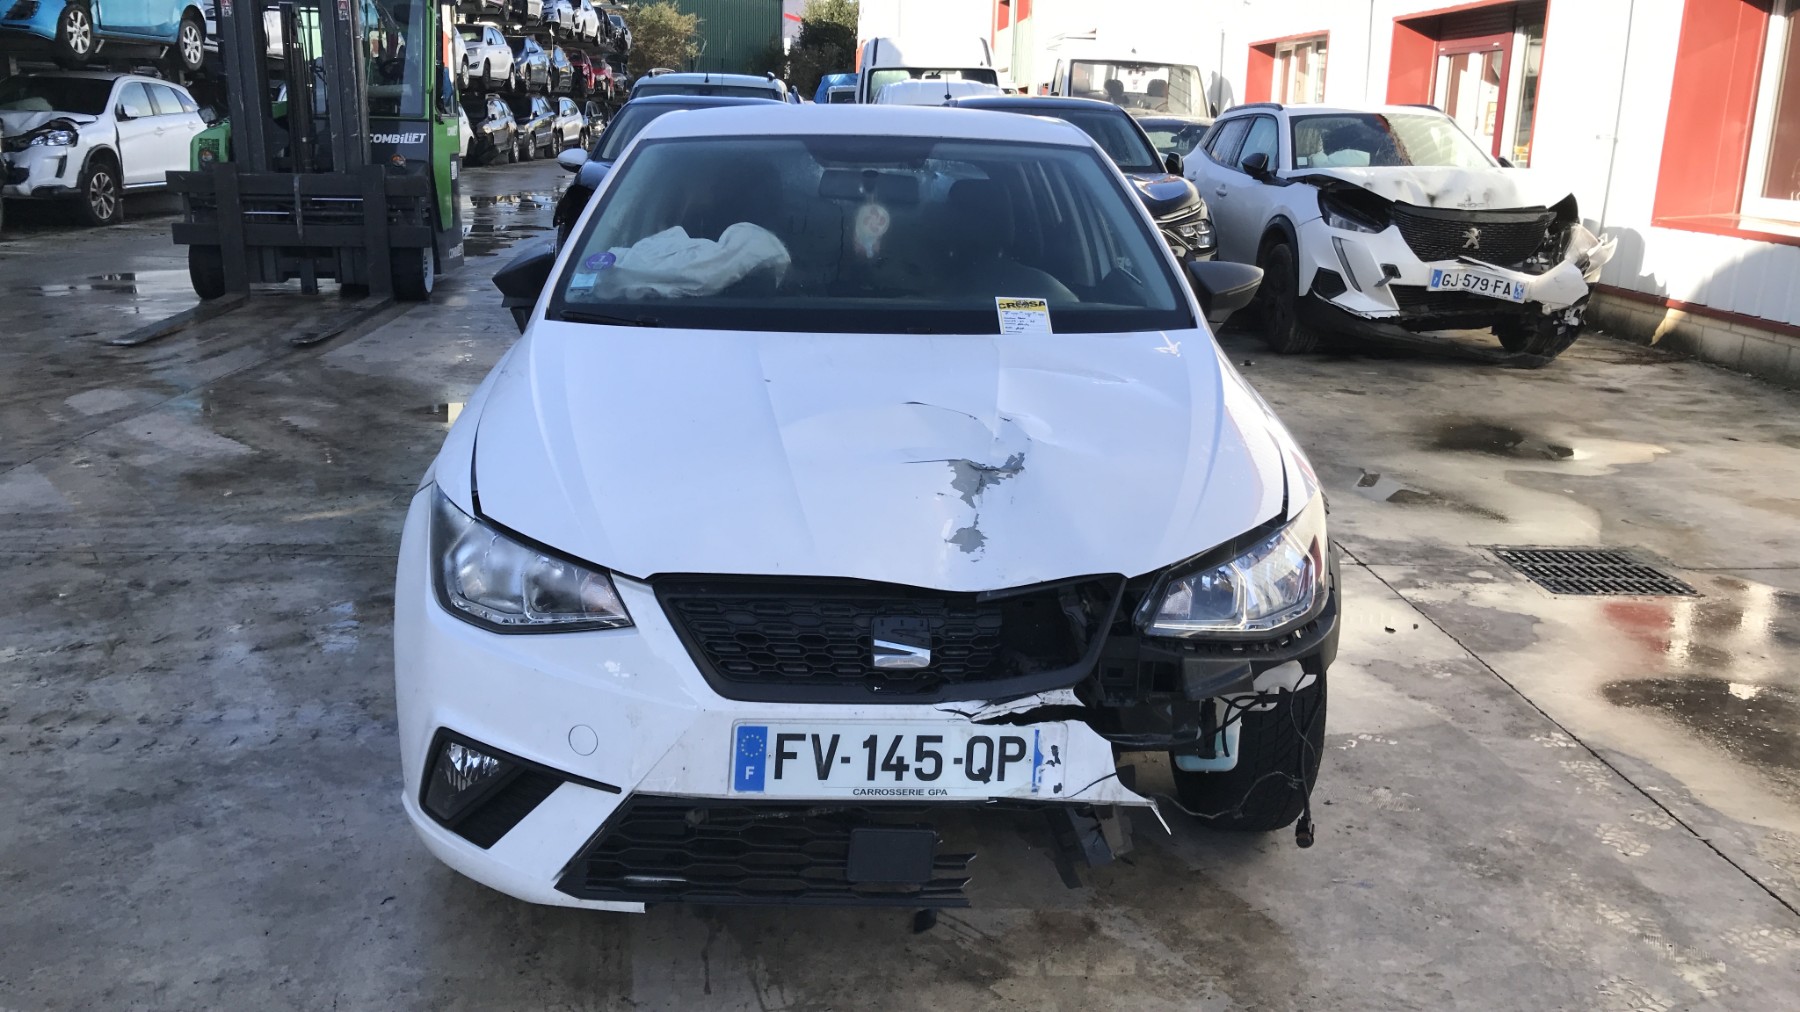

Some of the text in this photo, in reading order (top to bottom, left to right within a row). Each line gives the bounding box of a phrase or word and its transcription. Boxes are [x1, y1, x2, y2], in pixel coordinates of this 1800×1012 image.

[1441, 273, 1511, 296] GJ-579-FA
[773, 733, 1027, 784] FV-145-QP
[744, 766, 755, 780] F
[852, 787, 948, 797] CARROSSERIE GPA
